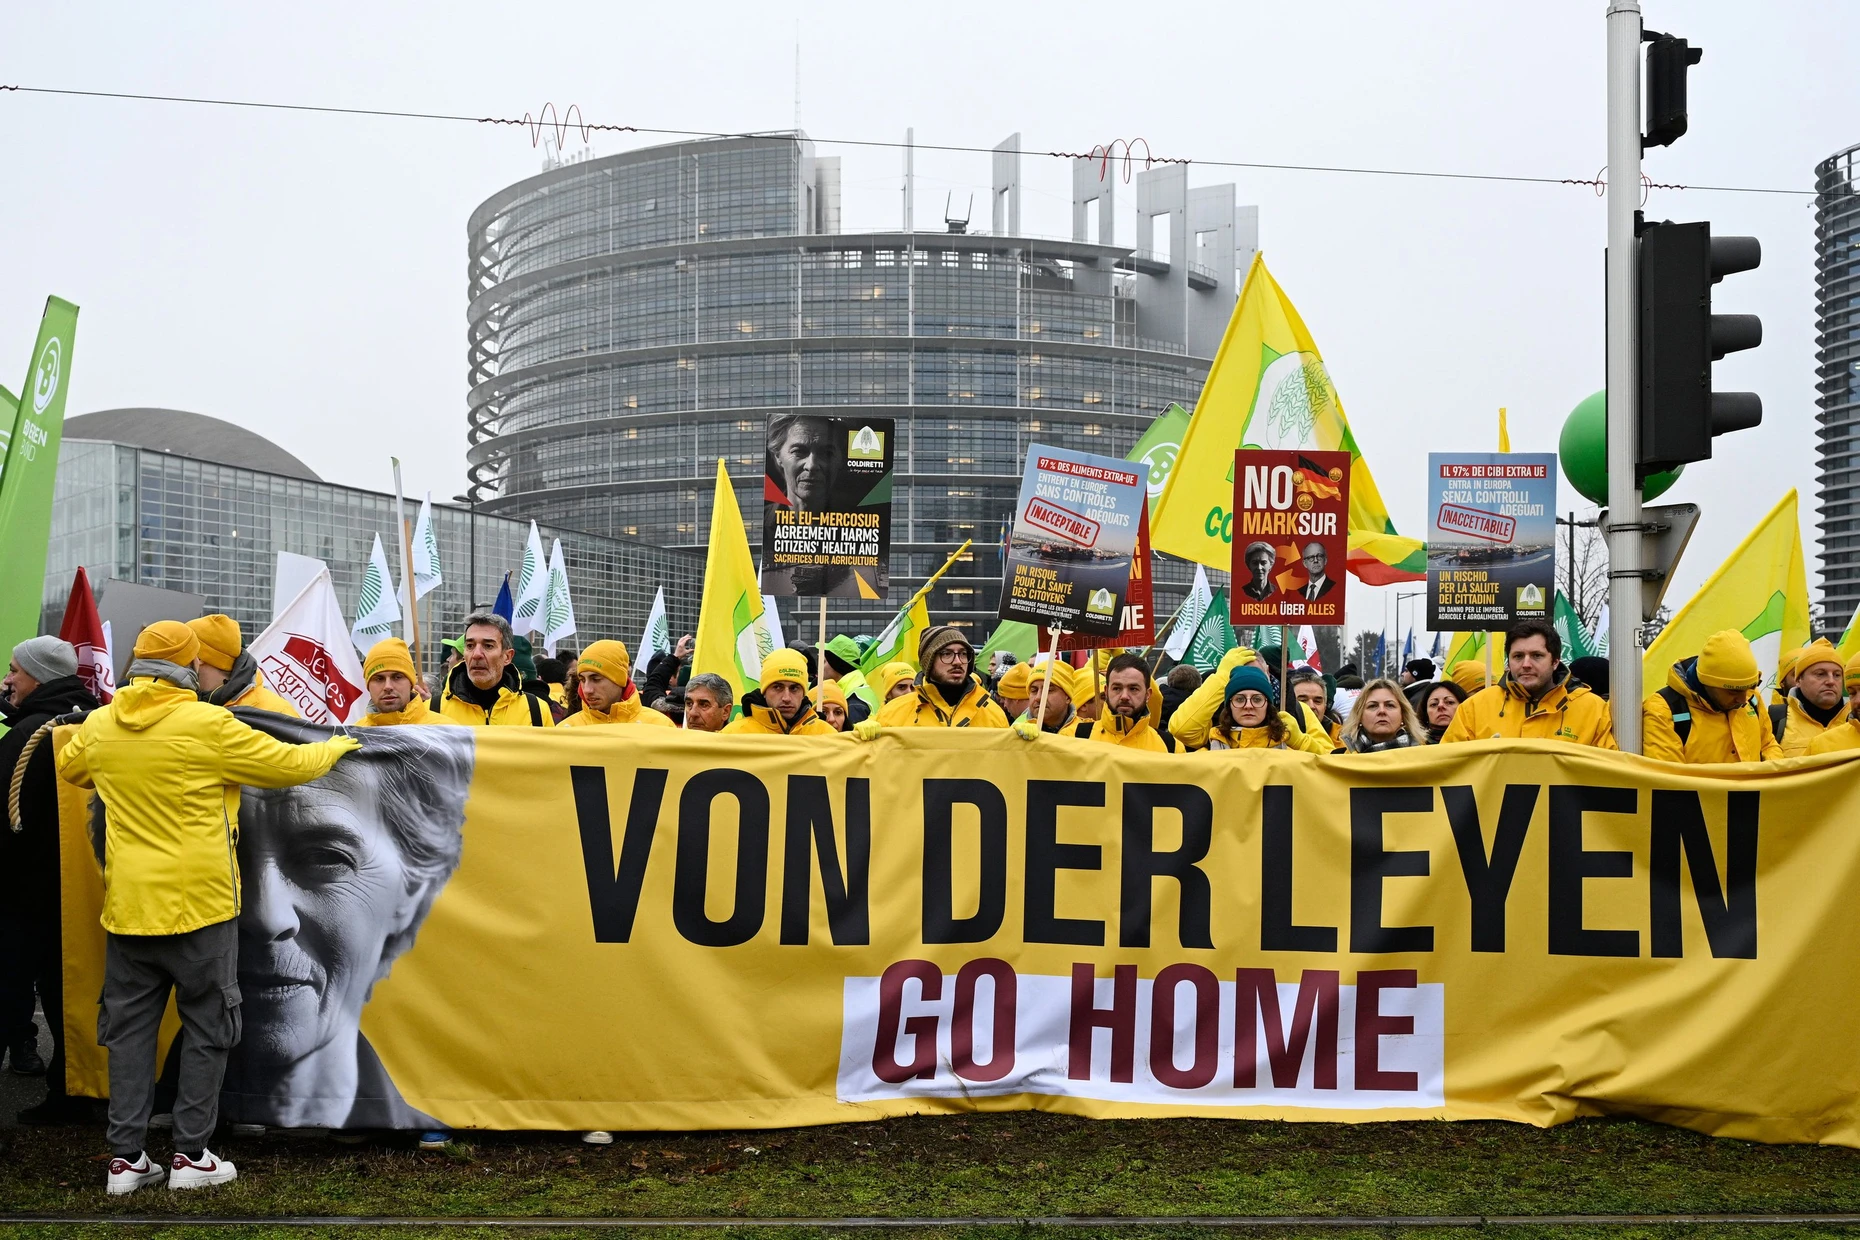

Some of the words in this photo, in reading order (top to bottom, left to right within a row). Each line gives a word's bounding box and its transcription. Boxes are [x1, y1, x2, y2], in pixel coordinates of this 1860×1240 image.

[847, 460, 884, 468] COLDIRETTI
[1040, 459, 1048, 468] 97
[1057, 462, 1070, 472] DES
[1071, 463, 1102, 478] ALIMENTS
[1104, 468, 1135, 484] EXTRA-UE
[1443, 466, 1450, 477] IL
[1452, 466, 1470, 477] 97%
[1472, 466, 1485, 477] DEI
[1487, 466, 1504, 477] CIBI
[1506, 466, 1532, 477] EXTRA
[1534, 466, 1544, 477] UE
[1038, 472, 1068, 486] ENTRENT
[1070, 478, 1079, 488] EN
[1081, 480, 1108, 494] EUROPE
[1244, 465, 1294, 510] NO
[1448, 480, 1472, 490] ENTRA
[1473, 480, 1481, 490] IN
[1483, 480, 1512, 490] EUROPA
[1035, 484, 1061, 499] SANS
[1063, 486, 1117, 509] CONTRÔLES
[1442, 491, 1473, 504] SENZA
[1476, 491, 1529, 504] CONTROLLI
[775, 510, 795, 525] THE
[1085, 508, 1130, 527] ADÉQUATS
[1499, 504, 1544, 516] ADEGUATI
[1030, 504, 1091, 539] INACCEPTABLE
[1242, 511, 1337, 536] MARKSUR
[1442, 509, 1511, 537] INACCETTABILE
[774, 525, 838, 541] AGREEMENT
[841, 527, 880, 542] HARMS
[774, 540, 819, 553] CITIZENS'
[822, 541, 856, 555] HEALTH
[859, 543, 879, 555] AND
[774, 553, 812, 564] SACRIFICES
[814, 555, 829, 565] OUR
[831, 555, 878, 566] AGRICULTURE
[1016, 564, 1028, 575] UN
[1029, 566, 1057, 581] RISQUE
[1439, 571, 1451, 582] UN
[1454, 571, 1488, 582] RISCHIO
[1014, 575, 1035, 588] POUR
[1037, 579, 1046, 590] LA
[1048, 581, 1073, 595] SANTÉ
[1439, 582, 1455, 593] PER
[1457, 582, 1468, 593] LA
[1470, 582, 1500, 593] SALUTE
[1012, 586, 1027, 598] DES
[1028, 589, 1066, 605] CITOYENS
[1439, 594, 1452, 604] DEI
[1455, 594, 1495, 605] CITTADINI
[1009, 603, 1031, 612] AGRICOLES
[1017, 599, 1037, 607] DOMMAGE
[1048, 603, 1056, 611] LES
[1055, 605, 1081, 615] ENTREPRISES
[1241, 603, 1277, 616] URSULA
[1280, 601, 1305, 616] ÜBER
[1307, 603, 1335, 616] ALLES
[1085, 612, 1113, 622] COLDIRETTI
[569, 765, 871, 947] VON
[921, 778, 1216, 950] DER
[1260, 783, 1761, 960] LEYEN
[872, 958, 1018, 1083] GO
[1069, 961, 1419, 1091] HOME
